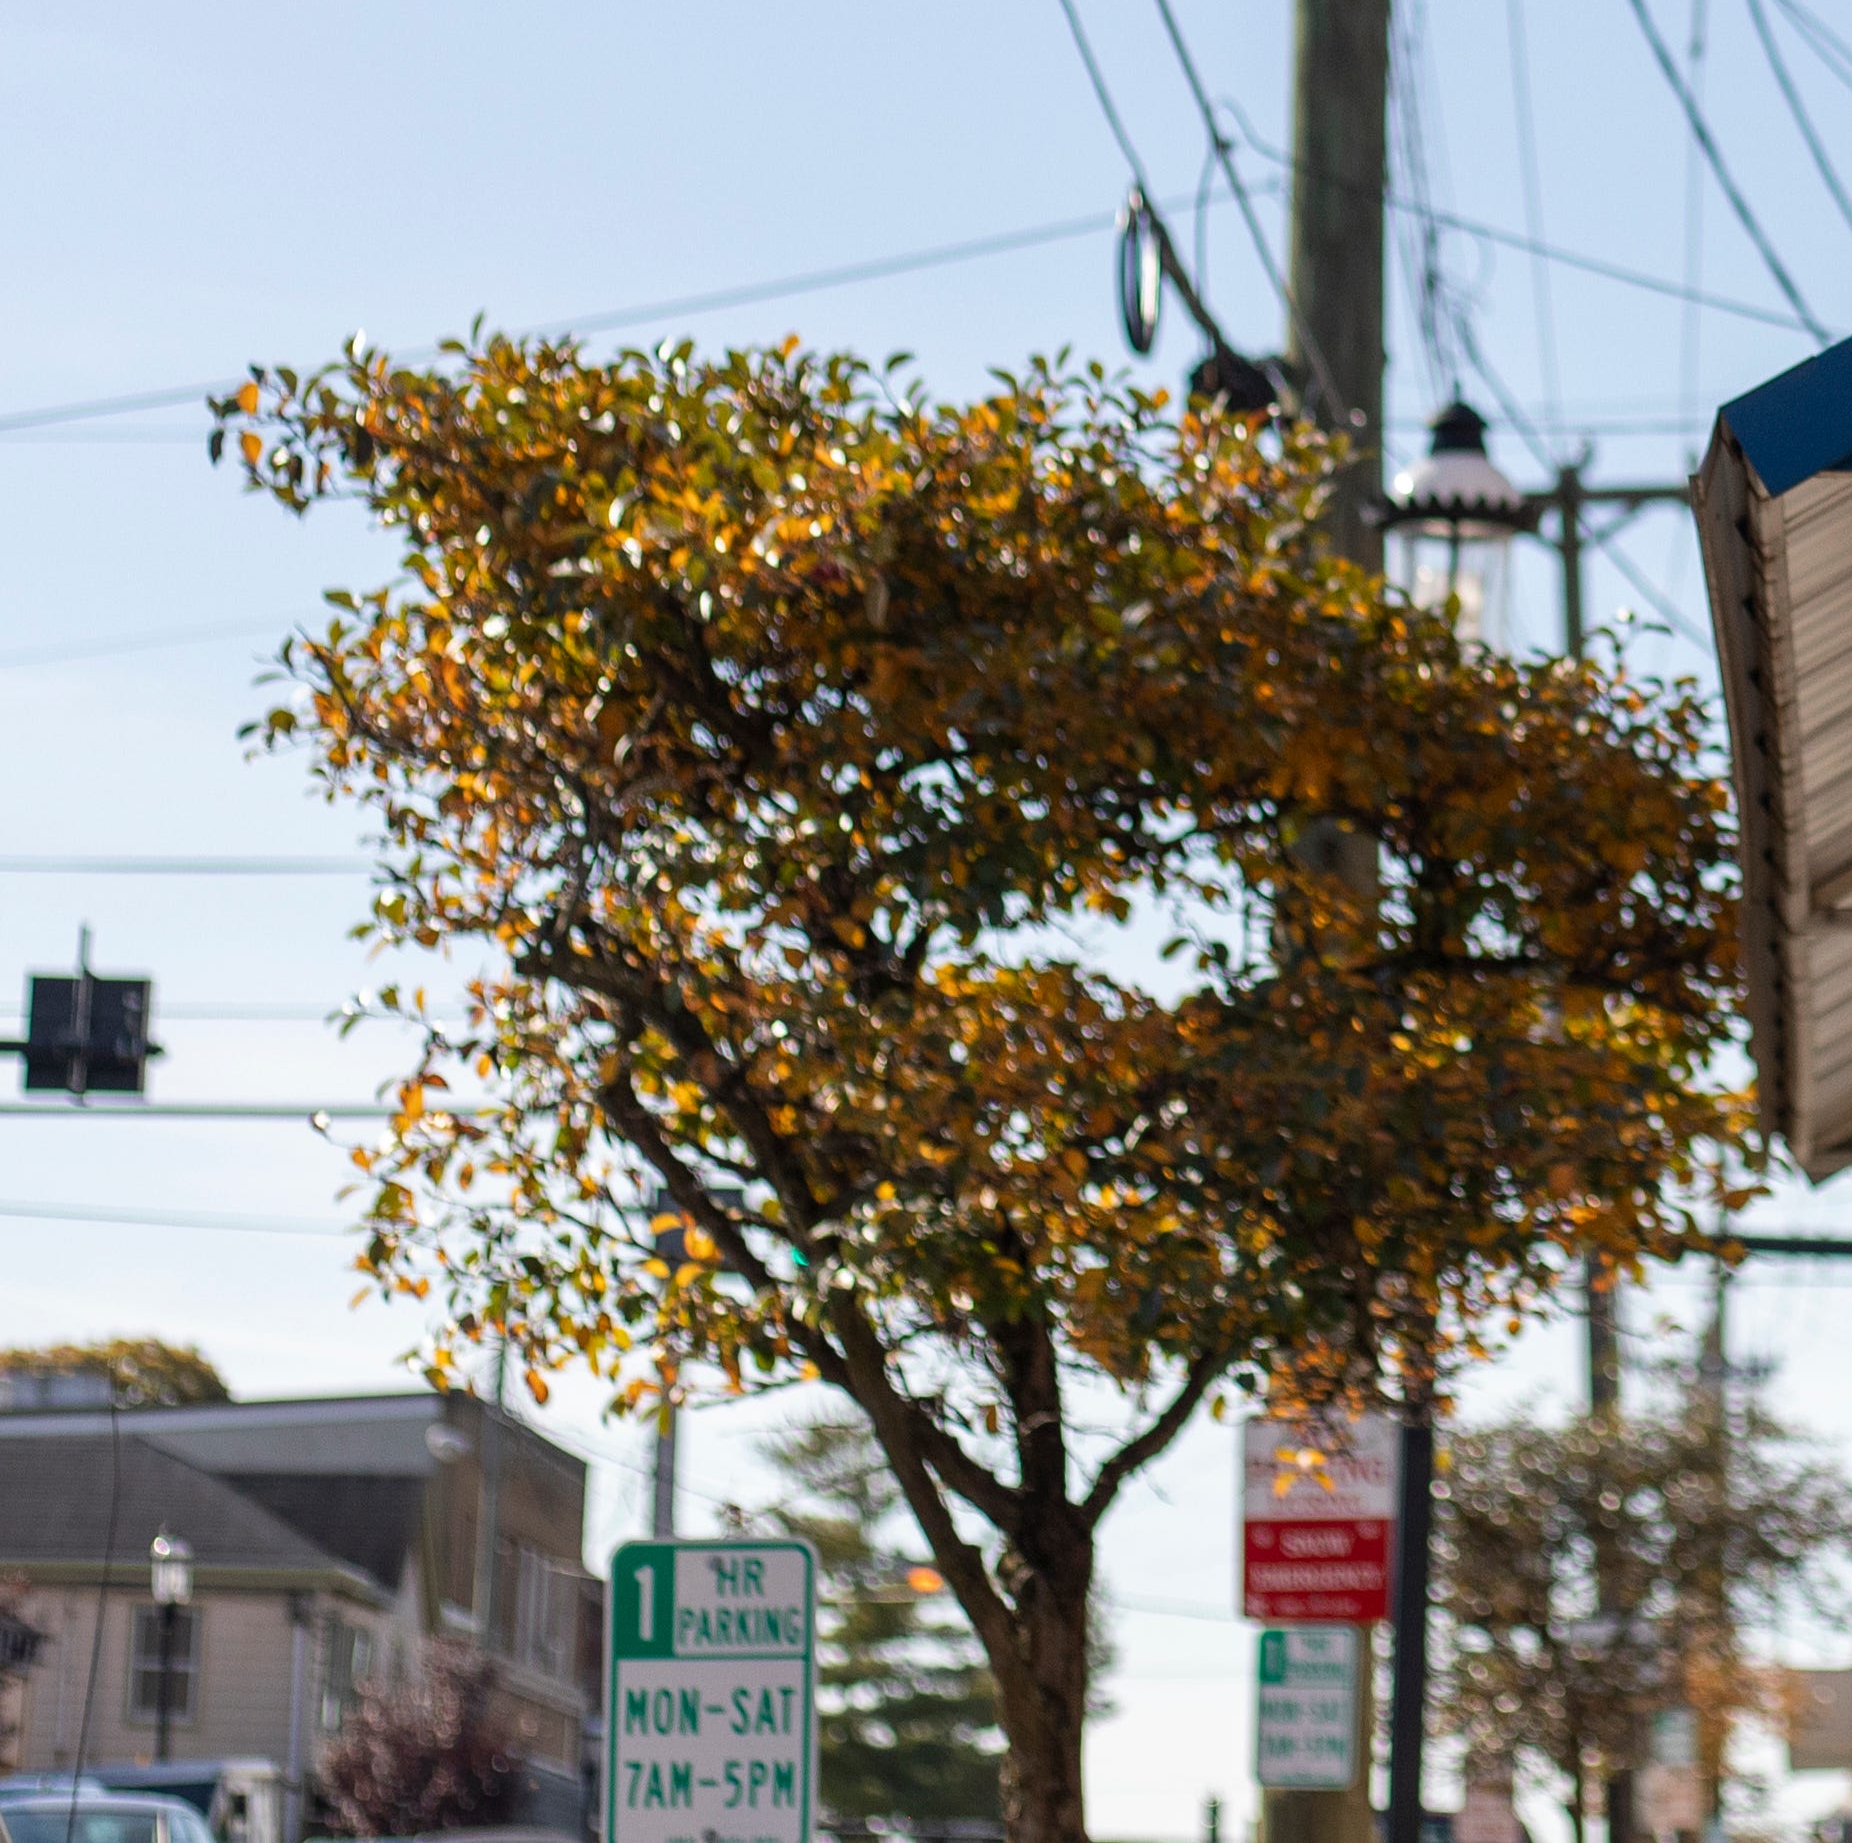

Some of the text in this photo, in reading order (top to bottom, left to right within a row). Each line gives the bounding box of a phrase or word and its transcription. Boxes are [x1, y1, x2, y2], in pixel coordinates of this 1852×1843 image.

[715, 1558, 765, 1597] HR
[634, 1565, 655, 1642] 1
[676, 1607, 803, 1645] PARKING
[625, 1688, 796, 1736] MON-SAT
[626, 1760, 796, 1808] 7AM-5PM
